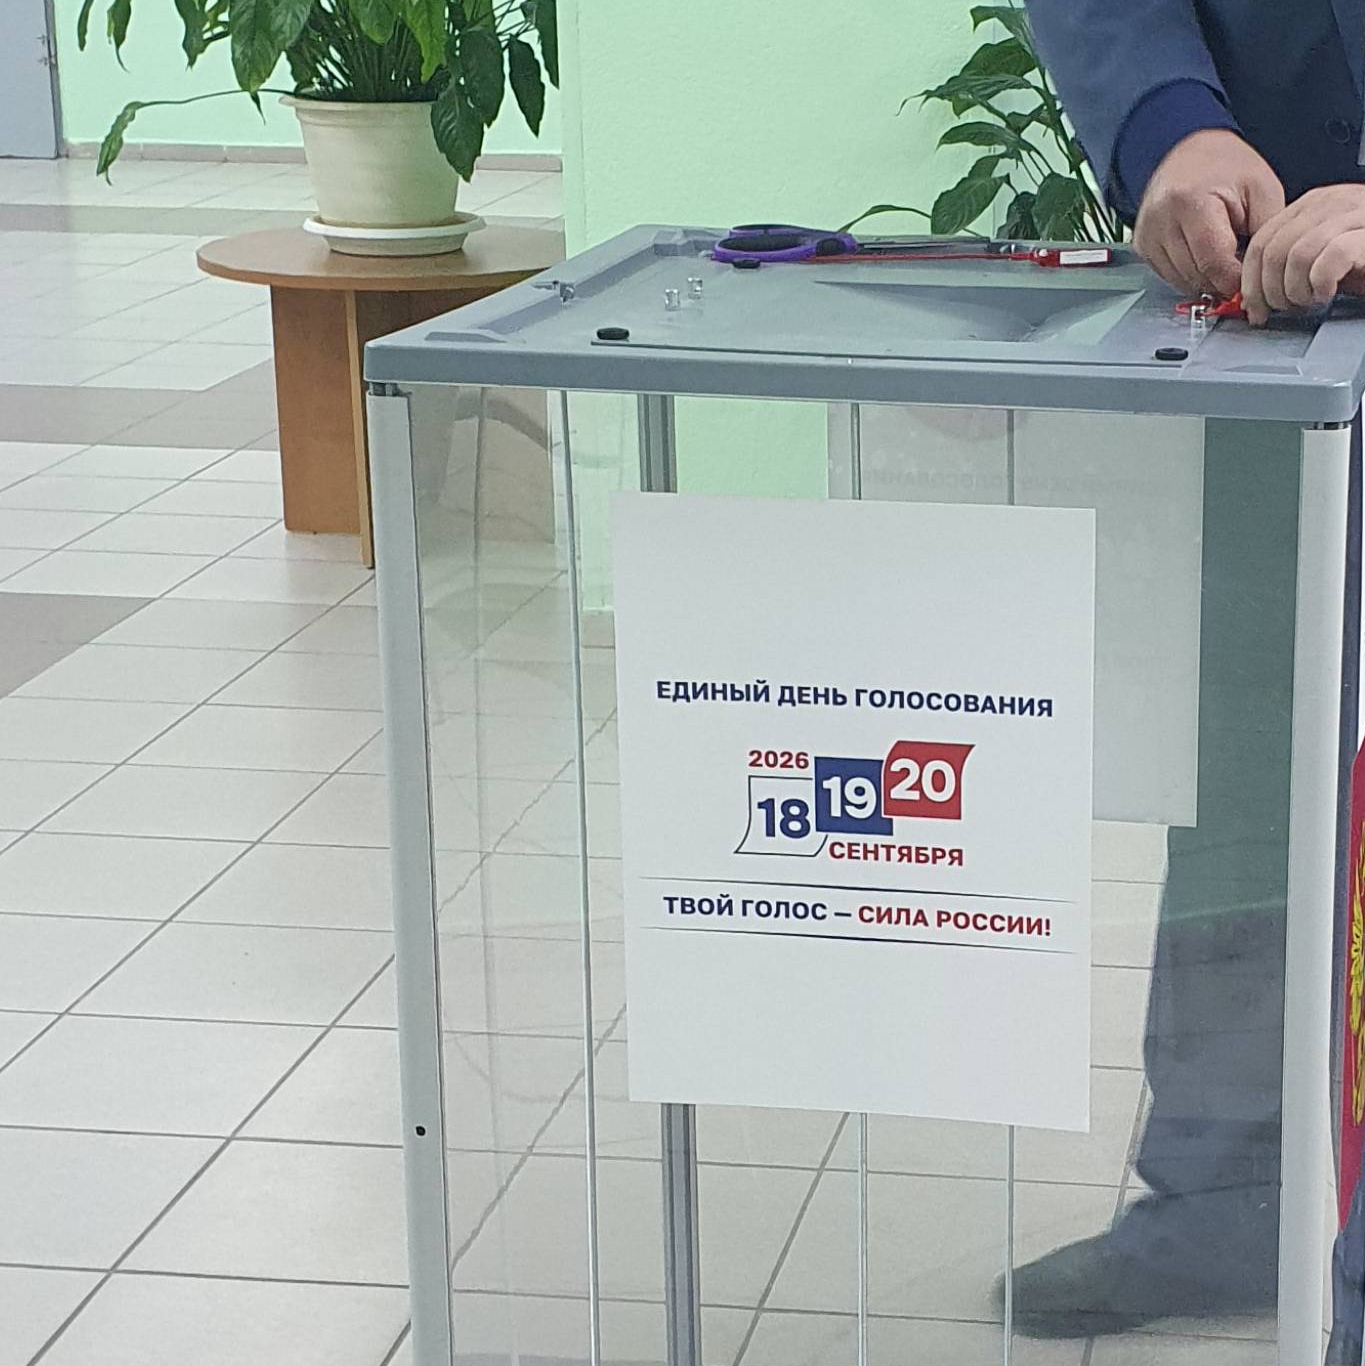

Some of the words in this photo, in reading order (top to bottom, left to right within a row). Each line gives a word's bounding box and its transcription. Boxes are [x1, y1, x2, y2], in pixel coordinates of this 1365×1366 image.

[656, 680, 771, 703] ЕДИНЫЙ
[777, 685, 847, 708] ДЕНЬ
[854, 688, 1054, 717] ГОЛОСОВАНИЯ
[748, 749, 810, 769] 2026
[821, 775, 877, 820] 19
[888, 758, 957, 803] 20
[757, 797, 811, 839] 18
[828, 841, 964, 867] СЕНТЯБРЯ
[663, 893, 734, 917] ТВОЙ
[741, 899, 828, 922] ГОЛОС
[858, 905, 928, 928] СИЛА
[936, 910, 1052, 937] РОССИИ!
